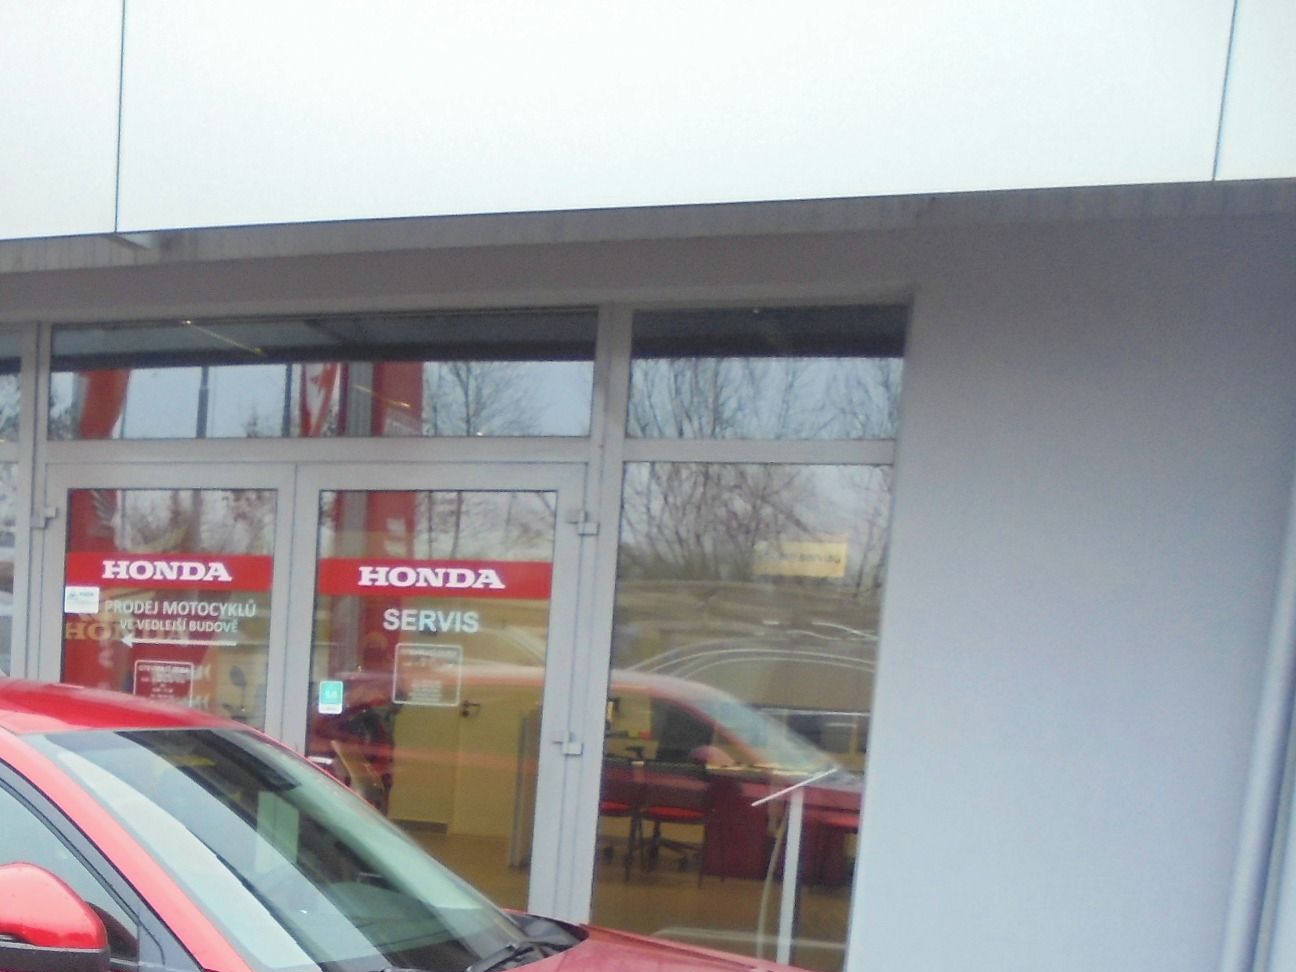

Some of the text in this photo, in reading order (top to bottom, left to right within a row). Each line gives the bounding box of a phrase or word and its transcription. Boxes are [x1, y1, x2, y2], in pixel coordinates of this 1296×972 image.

[102, 560, 232, 582] HONDA
[357, 565, 505, 589] HONDA
[105, 599, 256, 618] PRODEJ MOTOCYKLŮ
[137, 618, 186, 632] VEDLEJŠÍ
[189, 619, 239, 633] BUDOVĚ
[383, 608, 480, 634] SERVIS
